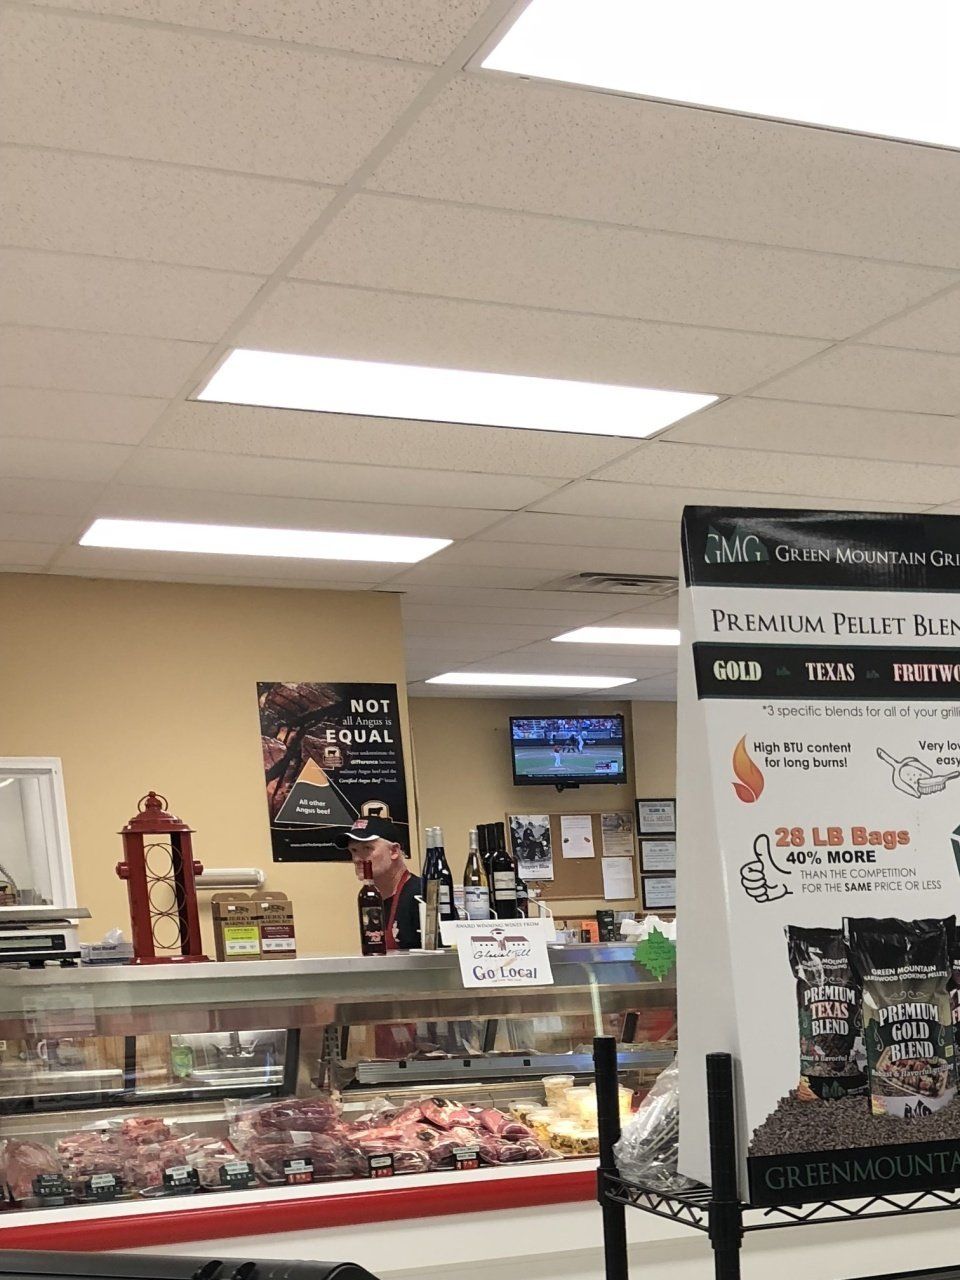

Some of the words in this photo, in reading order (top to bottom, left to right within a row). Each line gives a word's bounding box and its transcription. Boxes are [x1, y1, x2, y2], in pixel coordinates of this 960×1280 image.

[705, 534, 760, 563] GMG
[776, 545, 830, 562] GREEN
[836, 548, 926, 564] MOUNTAIN
[711, 609, 825, 633] PREMIUM
[833, 613, 905, 635] PELLET
[713, 661, 762, 680] GOLD
[805, 663, 854, 681] TEXAS
[351, 700, 389, 712] NOT
[778, 705, 821, 718] specific
[825, 705, 863, 716] blends
[866, 706, 881, 716] for
[884, 706, 896, 717] all
[900, 706, 911, 717] of
[915, 709, 937, 719] your
[343, 716, 352, 725] all
[356, 717, 382, 728] Angus
[386, 717, 391, 725] is
[326, 730, 393, 745] EQUAL
[754, 742, 780, 755] High
[784, 743, 803, 752] BTU
[807, 743, 851, 753] content
[919, 741, 944, 753] Very
[765, 757, 781, 768] for
[784, 757, 809, 770] long
[813, 757, 847, 768] burns!
[775, 827, 804, 847] 28
[812, 827, 844, 846] LB
[852, 826, 910, 849] Bags
[786, 852, 821, 864] 40%
[828, 851, 876, 863] MORE
[800, 870, 828, 879] THAN
[830, 869, 847, 878] THE
[850, 868, 916, 878] COMPETITION
[802, 883, 823, 893] FOR
[825, 883, 842, 892] THE
[845, 882, 871, 891] SAME
[875, 882, 902, 891] PRICE
[905, 881, 919, 890] OR
[922, 880, 941, 889] LESS
[473, 966, 495, 980] Go
[500, 967, 536, 979] Local
[872, 966, 896, 975] GREEN
[898, 965, 936, 973] MOUNTAIN
[804, 986, 855, 1005] PREMIUM
[810, 1002, 848, 1020] TEXAS
[879, 1003, 939, 1026] PREMIUM
[812, 1018, 848, 1036] BLEND
[892, 1021, 929, 1040] GOLD
[891, 1041, 934, 1062] BLEND
